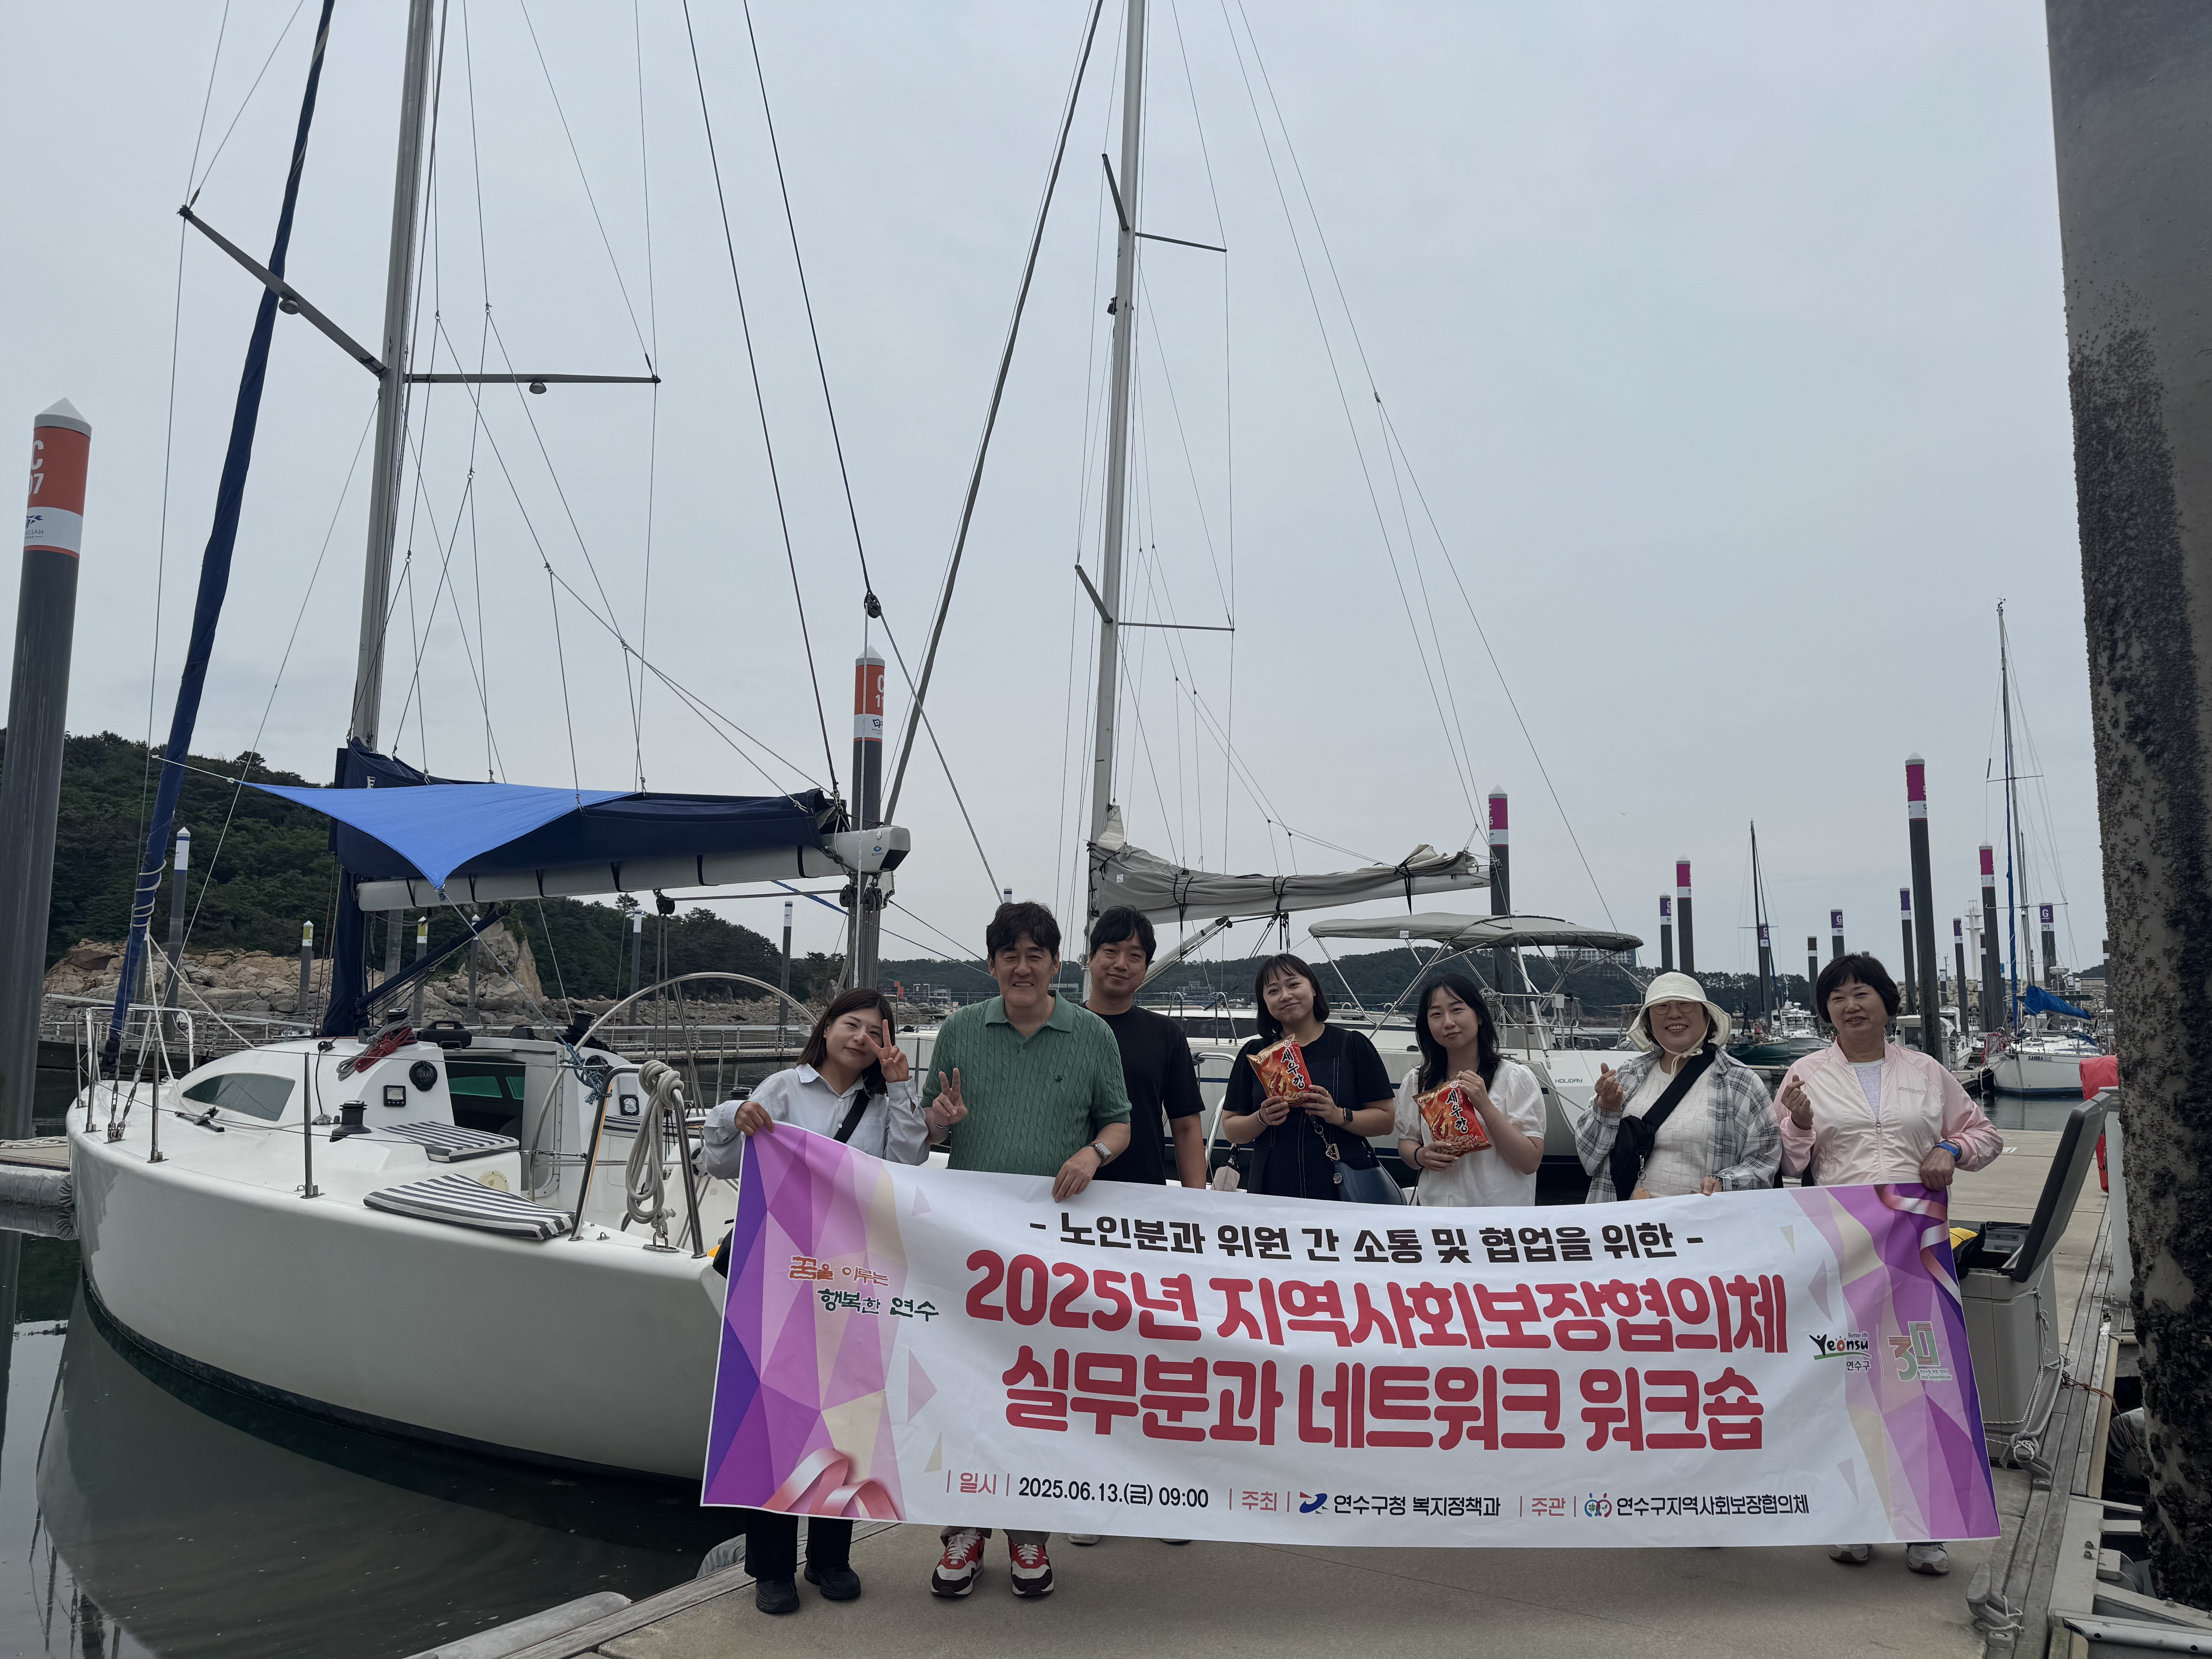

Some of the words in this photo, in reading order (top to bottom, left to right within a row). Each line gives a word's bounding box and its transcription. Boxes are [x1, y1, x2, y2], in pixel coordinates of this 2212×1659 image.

[1837, 915, 1842, 923] G
[2042, 909, 2049, 917] G
[1281, 1049, 1305, 1088] 새우깡
[1446, 1090, 1467, 1133] 새우깡
[1061, 1212, 1205, 1254] 노인분과
[1218, 1224, 1291, 1260] 위원
[1302, 1228, 1340, 1262] 간
[1353, 1229, 1422, 1263] 소통
[1432, 1229, 1472, 1263] 및
[1479, 1226, 1592, 1263] 협업을
[1602, 1222, 1677, 1259] 위한
[789, 1256, 834, 1280] 꿈을
[842, 1267, 889, 1286] 이루는
[817, 1288, 881, 1314] 행복한
[890, 1297, 939, 1322] 연수
[966, 1250, 1202, 1341] 2025년
[1209, 1274, 1788, 1353] 지역사회보장협의체
[1809, 1333, 1869, 1356] Yeonsu
[1846, 1361, 1870, 1371] 연수구
[1002, 1345, 1283, 1446] 실무분과
[1298, 1362, 1565, 1451] 네트워크
[1580, 1367, 1764, 1451] 워크숍
[960, 1473, 996, 1495] 일시
[1018, 1477, 1153, 1506] 2025.06.13.(금)
[1159, 1487, 1209, 1508] 09:00
[1242, 1491, 1277, 1511] 주최
[1334, 1494, 1406, 1516] 연수구청
[1413, 1496, 1501, 1517] 복지정책과
[1532, 1498, 1565, 1517] 주관
[1617, 1494, 1809, 1516] 연수구지역사회보장협의체
